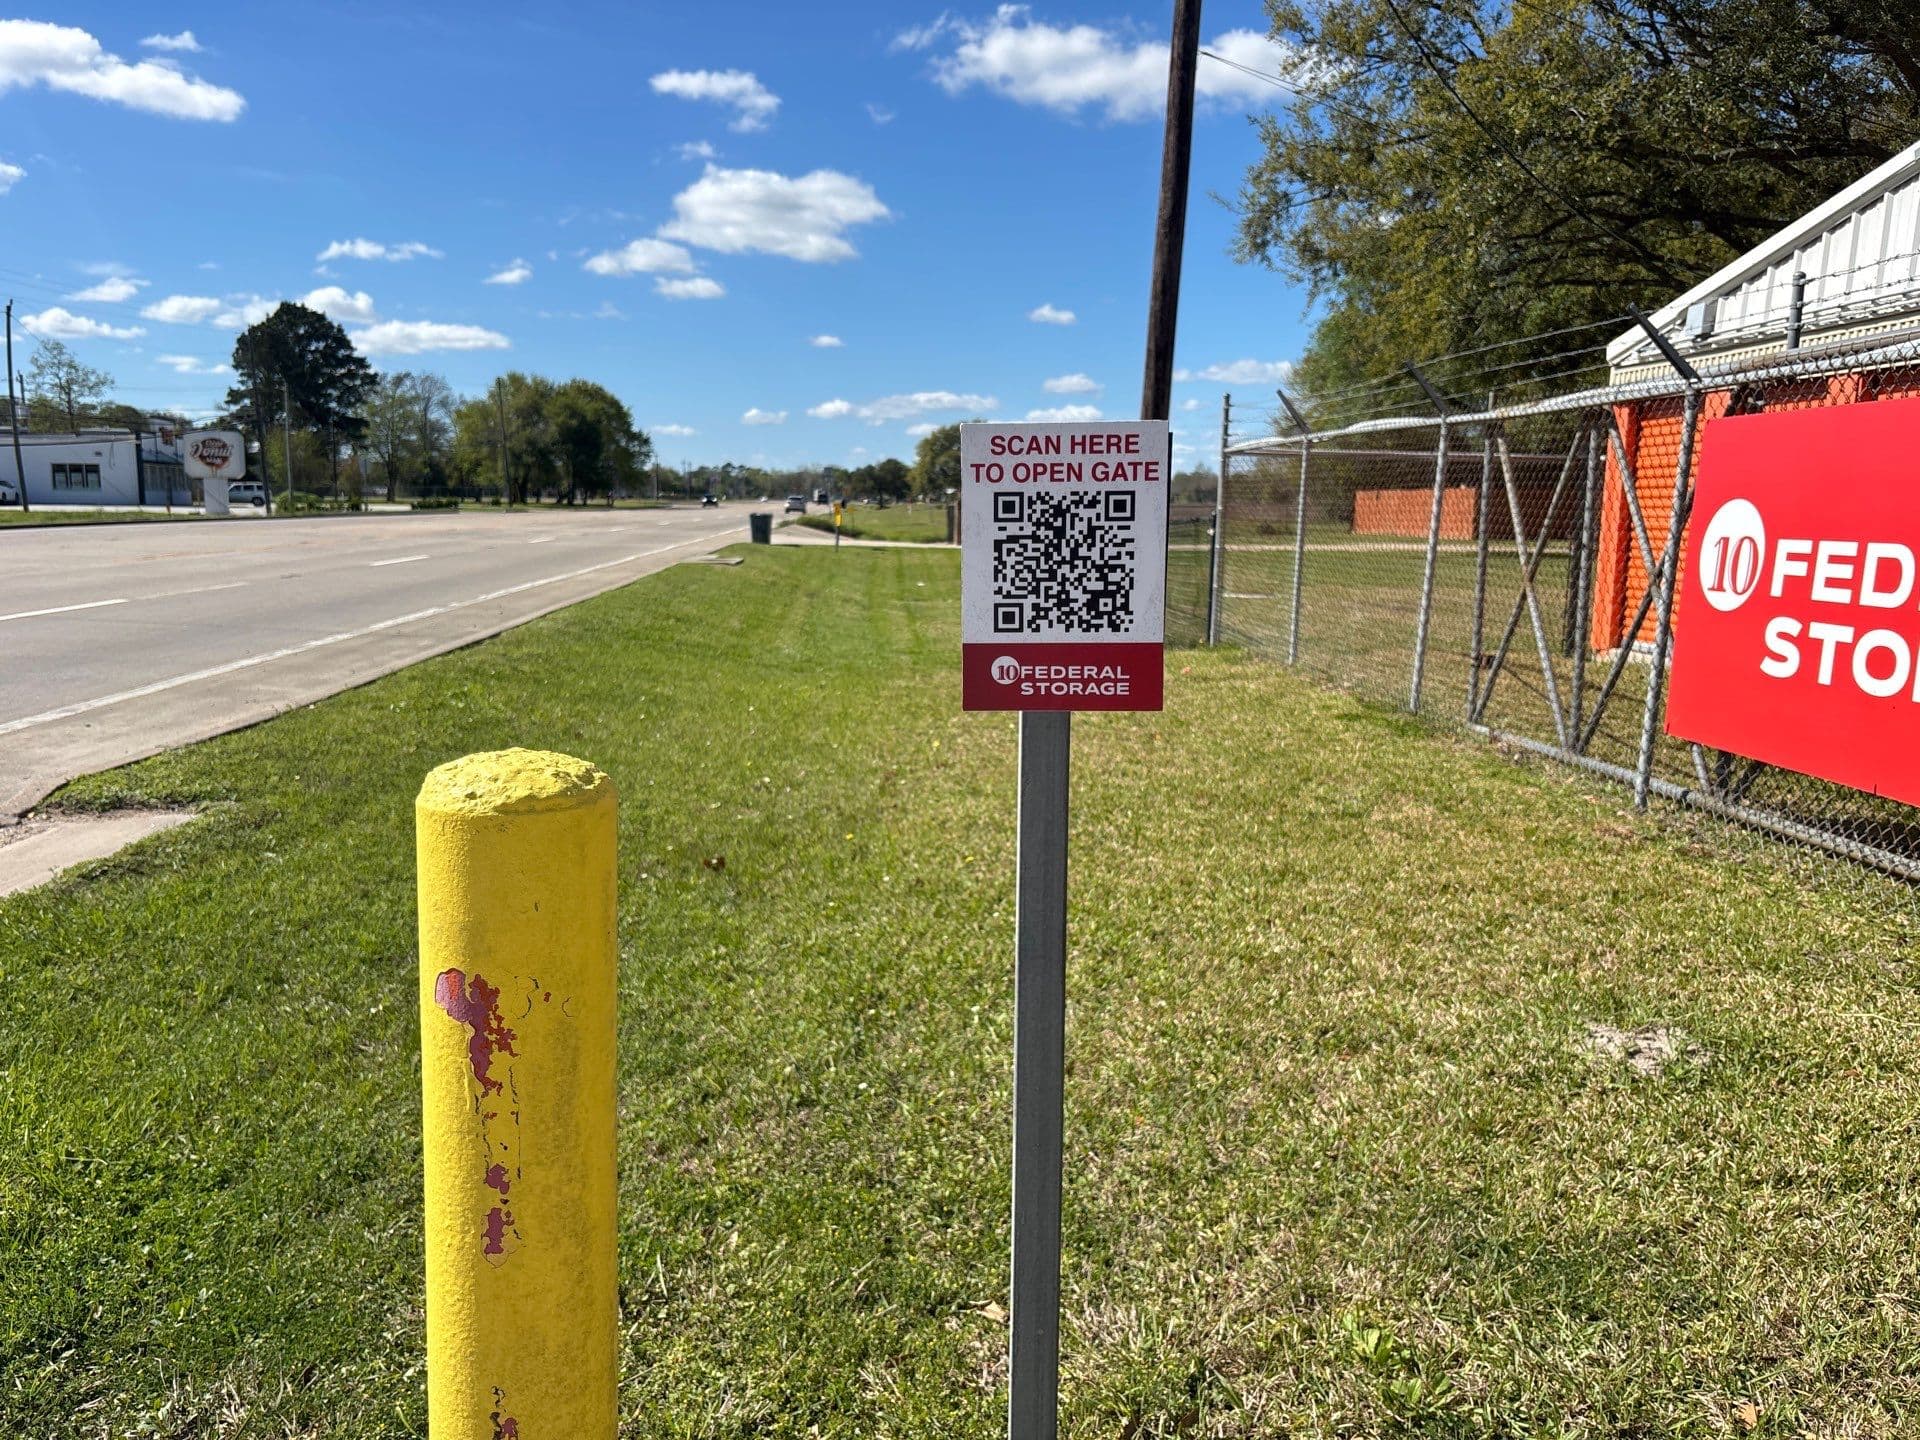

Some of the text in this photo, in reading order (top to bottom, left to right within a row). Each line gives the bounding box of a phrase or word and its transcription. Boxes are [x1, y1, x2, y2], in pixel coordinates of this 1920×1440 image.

[990, 433, 1140, 456] SCAN HERE
[970, 461, 1160, 484] TO OPEN GATE
[1707, 535, 1920, 611] 10 FED
[1759, 616, 1920, 703] STO
[996, 664, 1130, 682] 10 FEDERAL
[1020, 681, 1130, 696] STORAGE
